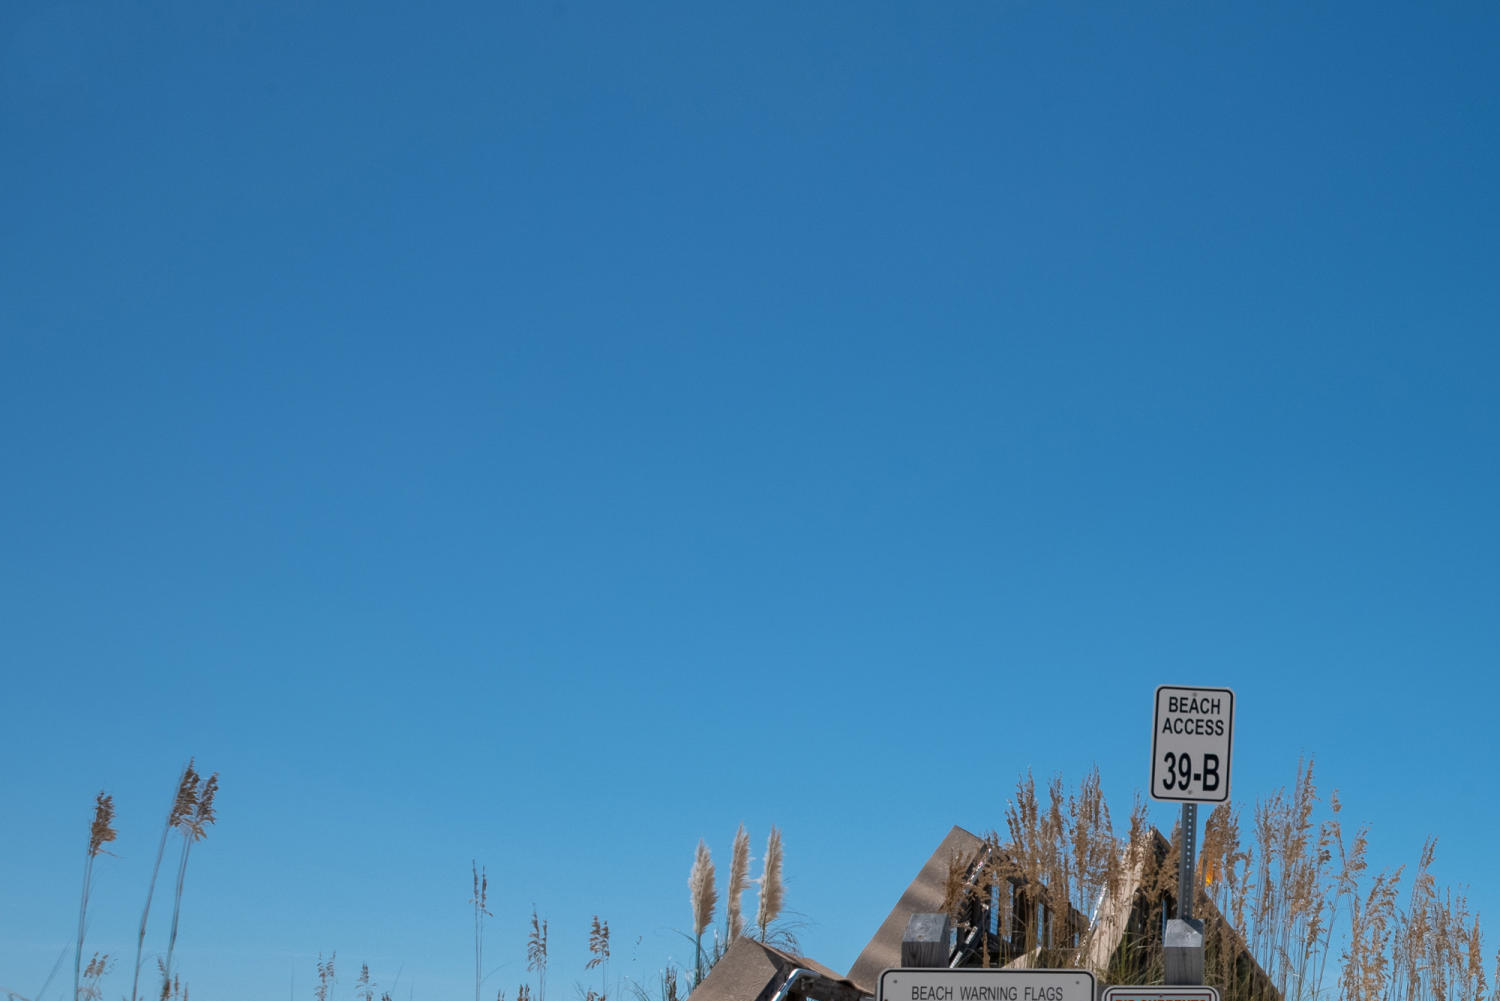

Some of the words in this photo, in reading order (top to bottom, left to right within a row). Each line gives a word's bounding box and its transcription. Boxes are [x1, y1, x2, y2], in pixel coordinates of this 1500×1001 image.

[1168, 696, 1221, 715] BEACH
[1162, 717, 1224, 736] ACCESS
[1162, 752, 1220, 792] 39-B
[911, 986, 953, 1001] BEACH
[960, 986, 1018, 1001] WARNING
[1024, 986, 1064, 1001] FLAGS
